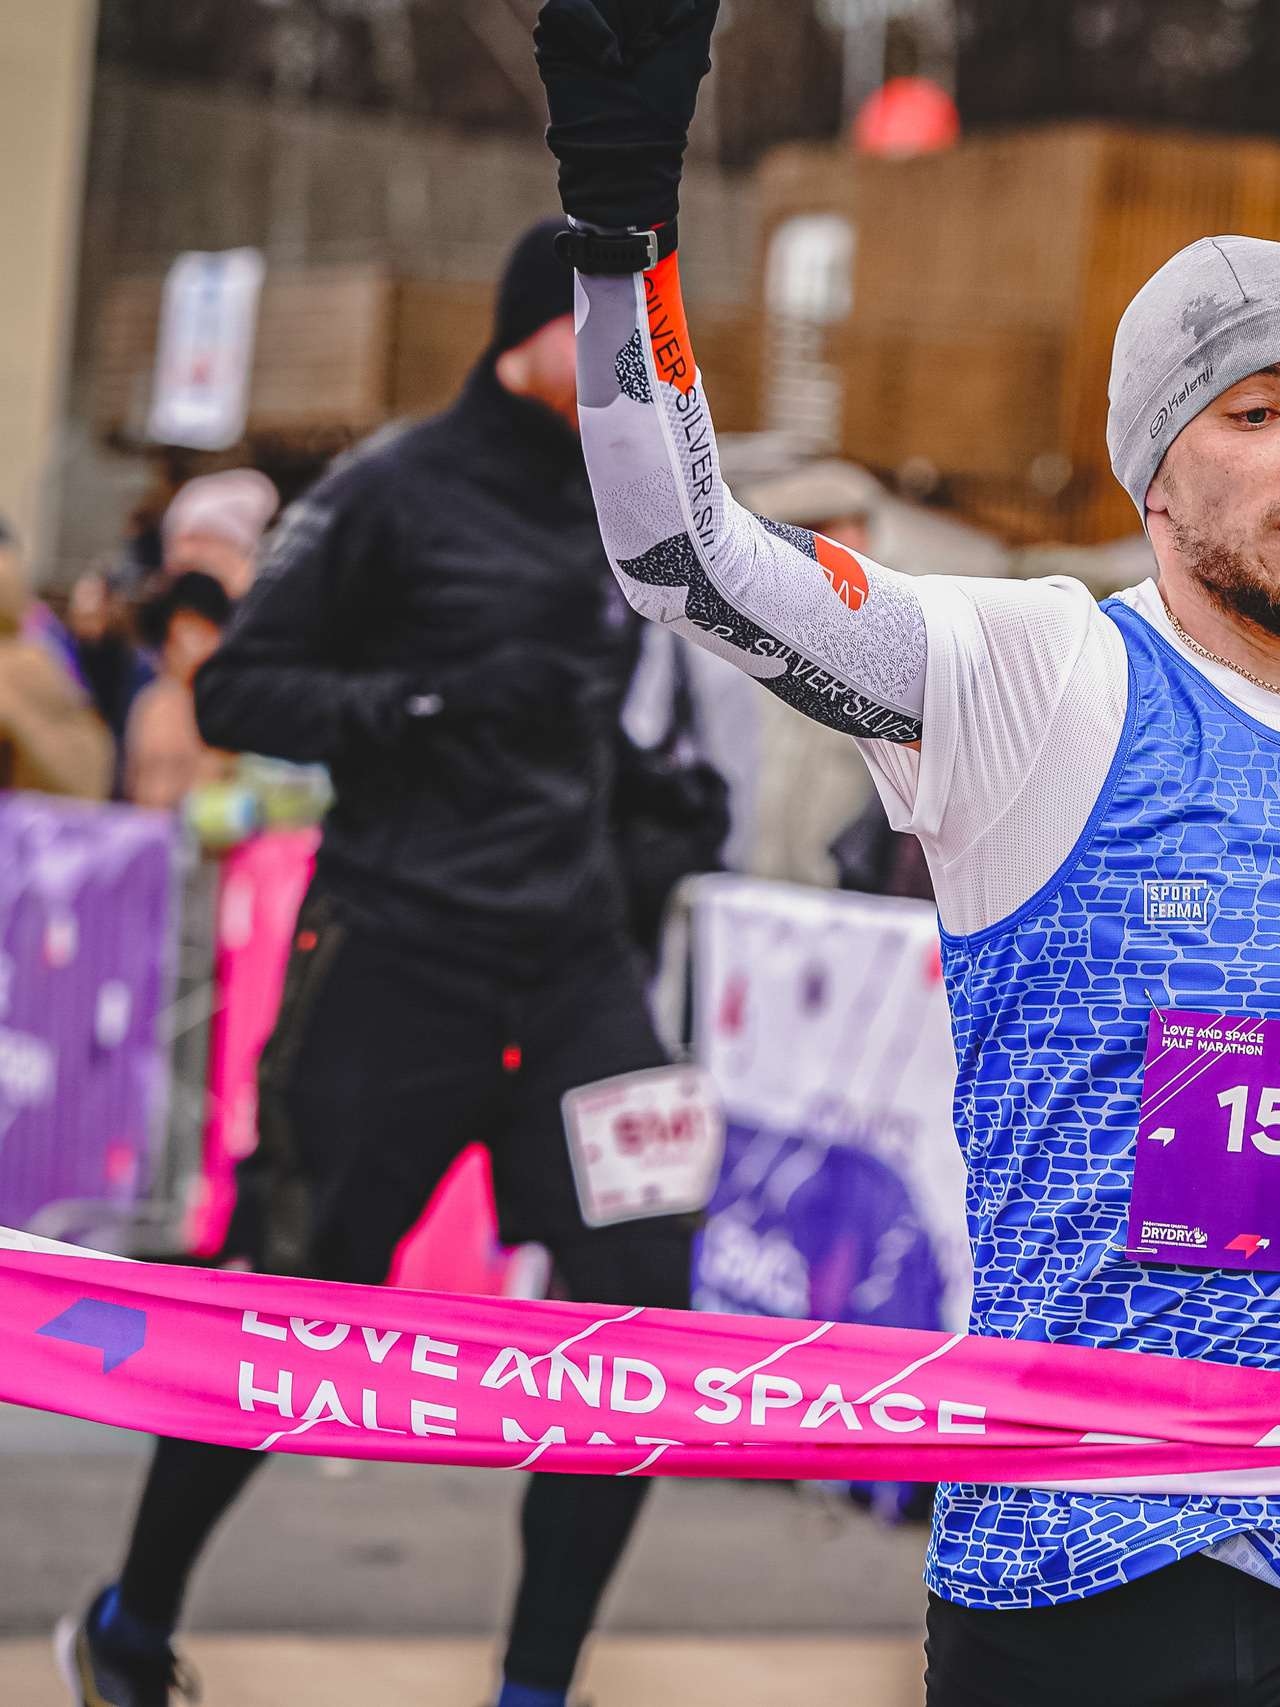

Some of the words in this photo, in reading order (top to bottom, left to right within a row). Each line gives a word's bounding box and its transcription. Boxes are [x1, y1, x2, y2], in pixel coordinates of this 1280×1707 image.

[1168, 363, 1214, 415] Kalenji
[676, 385, 713, 503] SILVER
[1150, 886, 1201, 901] SPORT
[1150, 903, 1202, 918] FERMA
[1161, 1036, 1194, 1049] HALF
[1196, 1027, 1223, 1040] AND
[1224, 1030, 1265, 1044] SPACE
[479, 1346, 667, 1414] AND
[694, 1367, 987, 1434] SPACE
